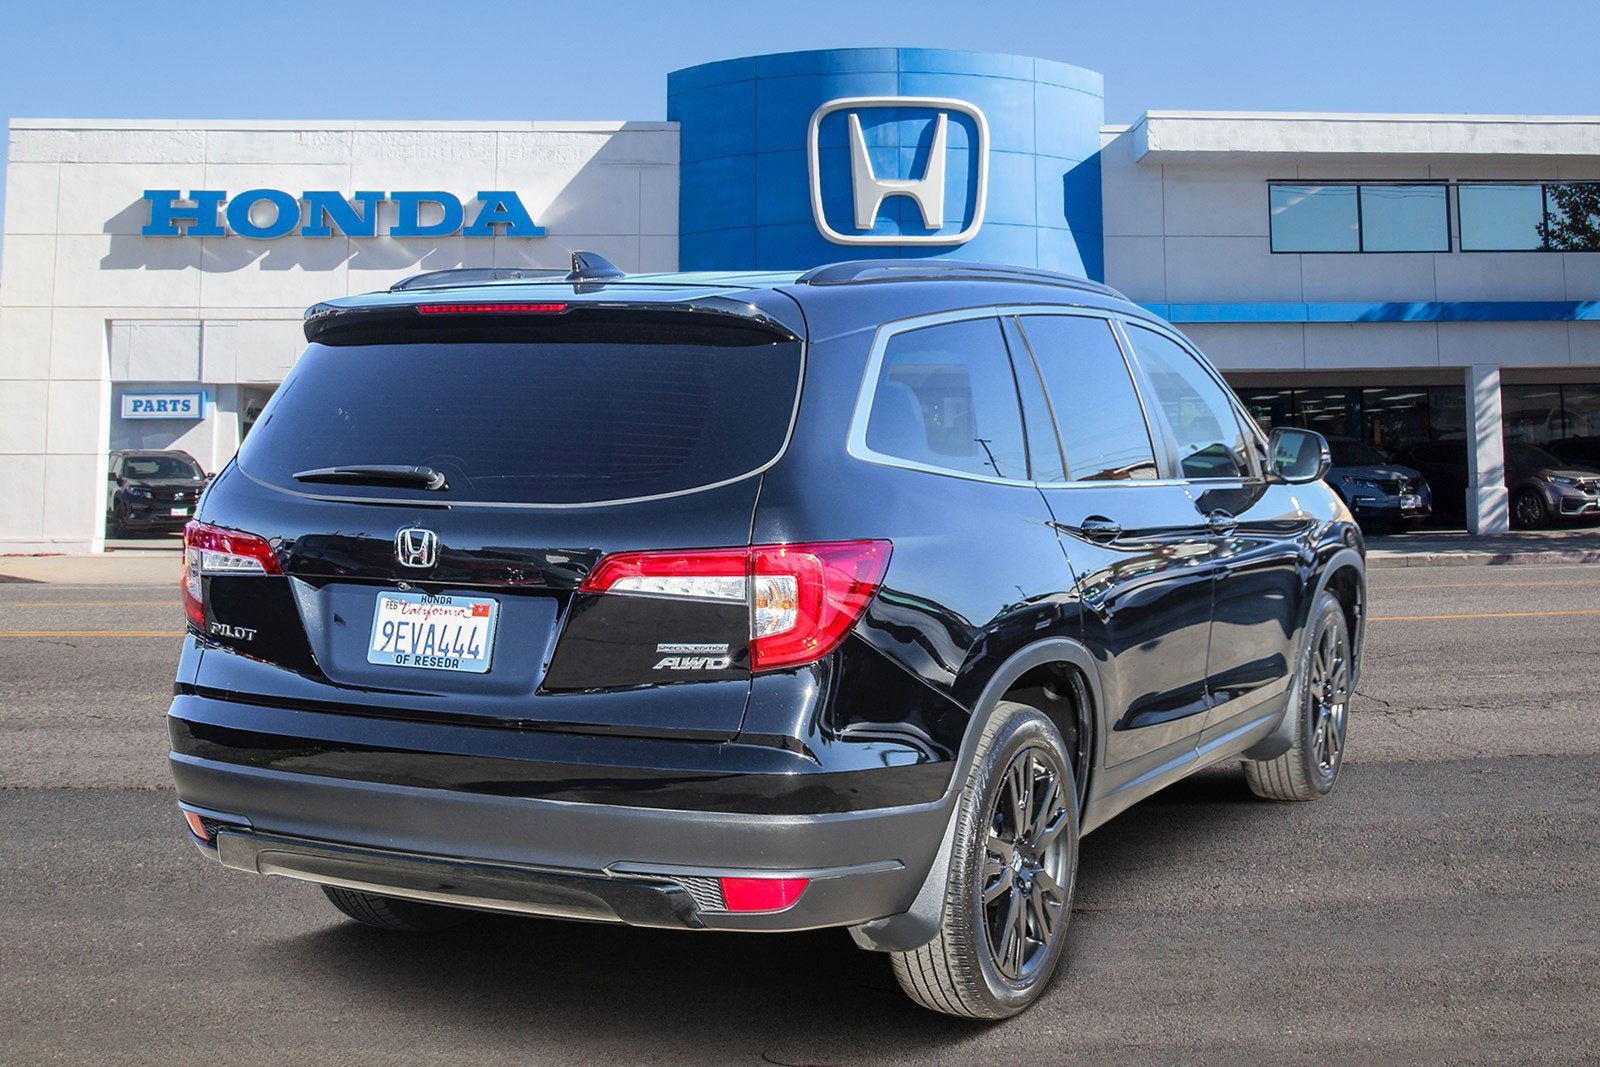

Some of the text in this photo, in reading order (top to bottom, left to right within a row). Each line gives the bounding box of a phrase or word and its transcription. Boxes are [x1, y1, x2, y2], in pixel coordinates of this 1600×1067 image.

[142, 188, 548, 240] HONDA
[132, 399, 191, 412] PARTS
[386, 600, 398, 610] FEB
[421, 595, 452, 605] HONDA
[401, 602, 472, 620] California
[211, 621, 257, 641] PILOT
[380, 620, 480, 659] 9EVA444
[395, 654, 459, 669] OF RESEDA
[652, 656, 731, 670] AWD
